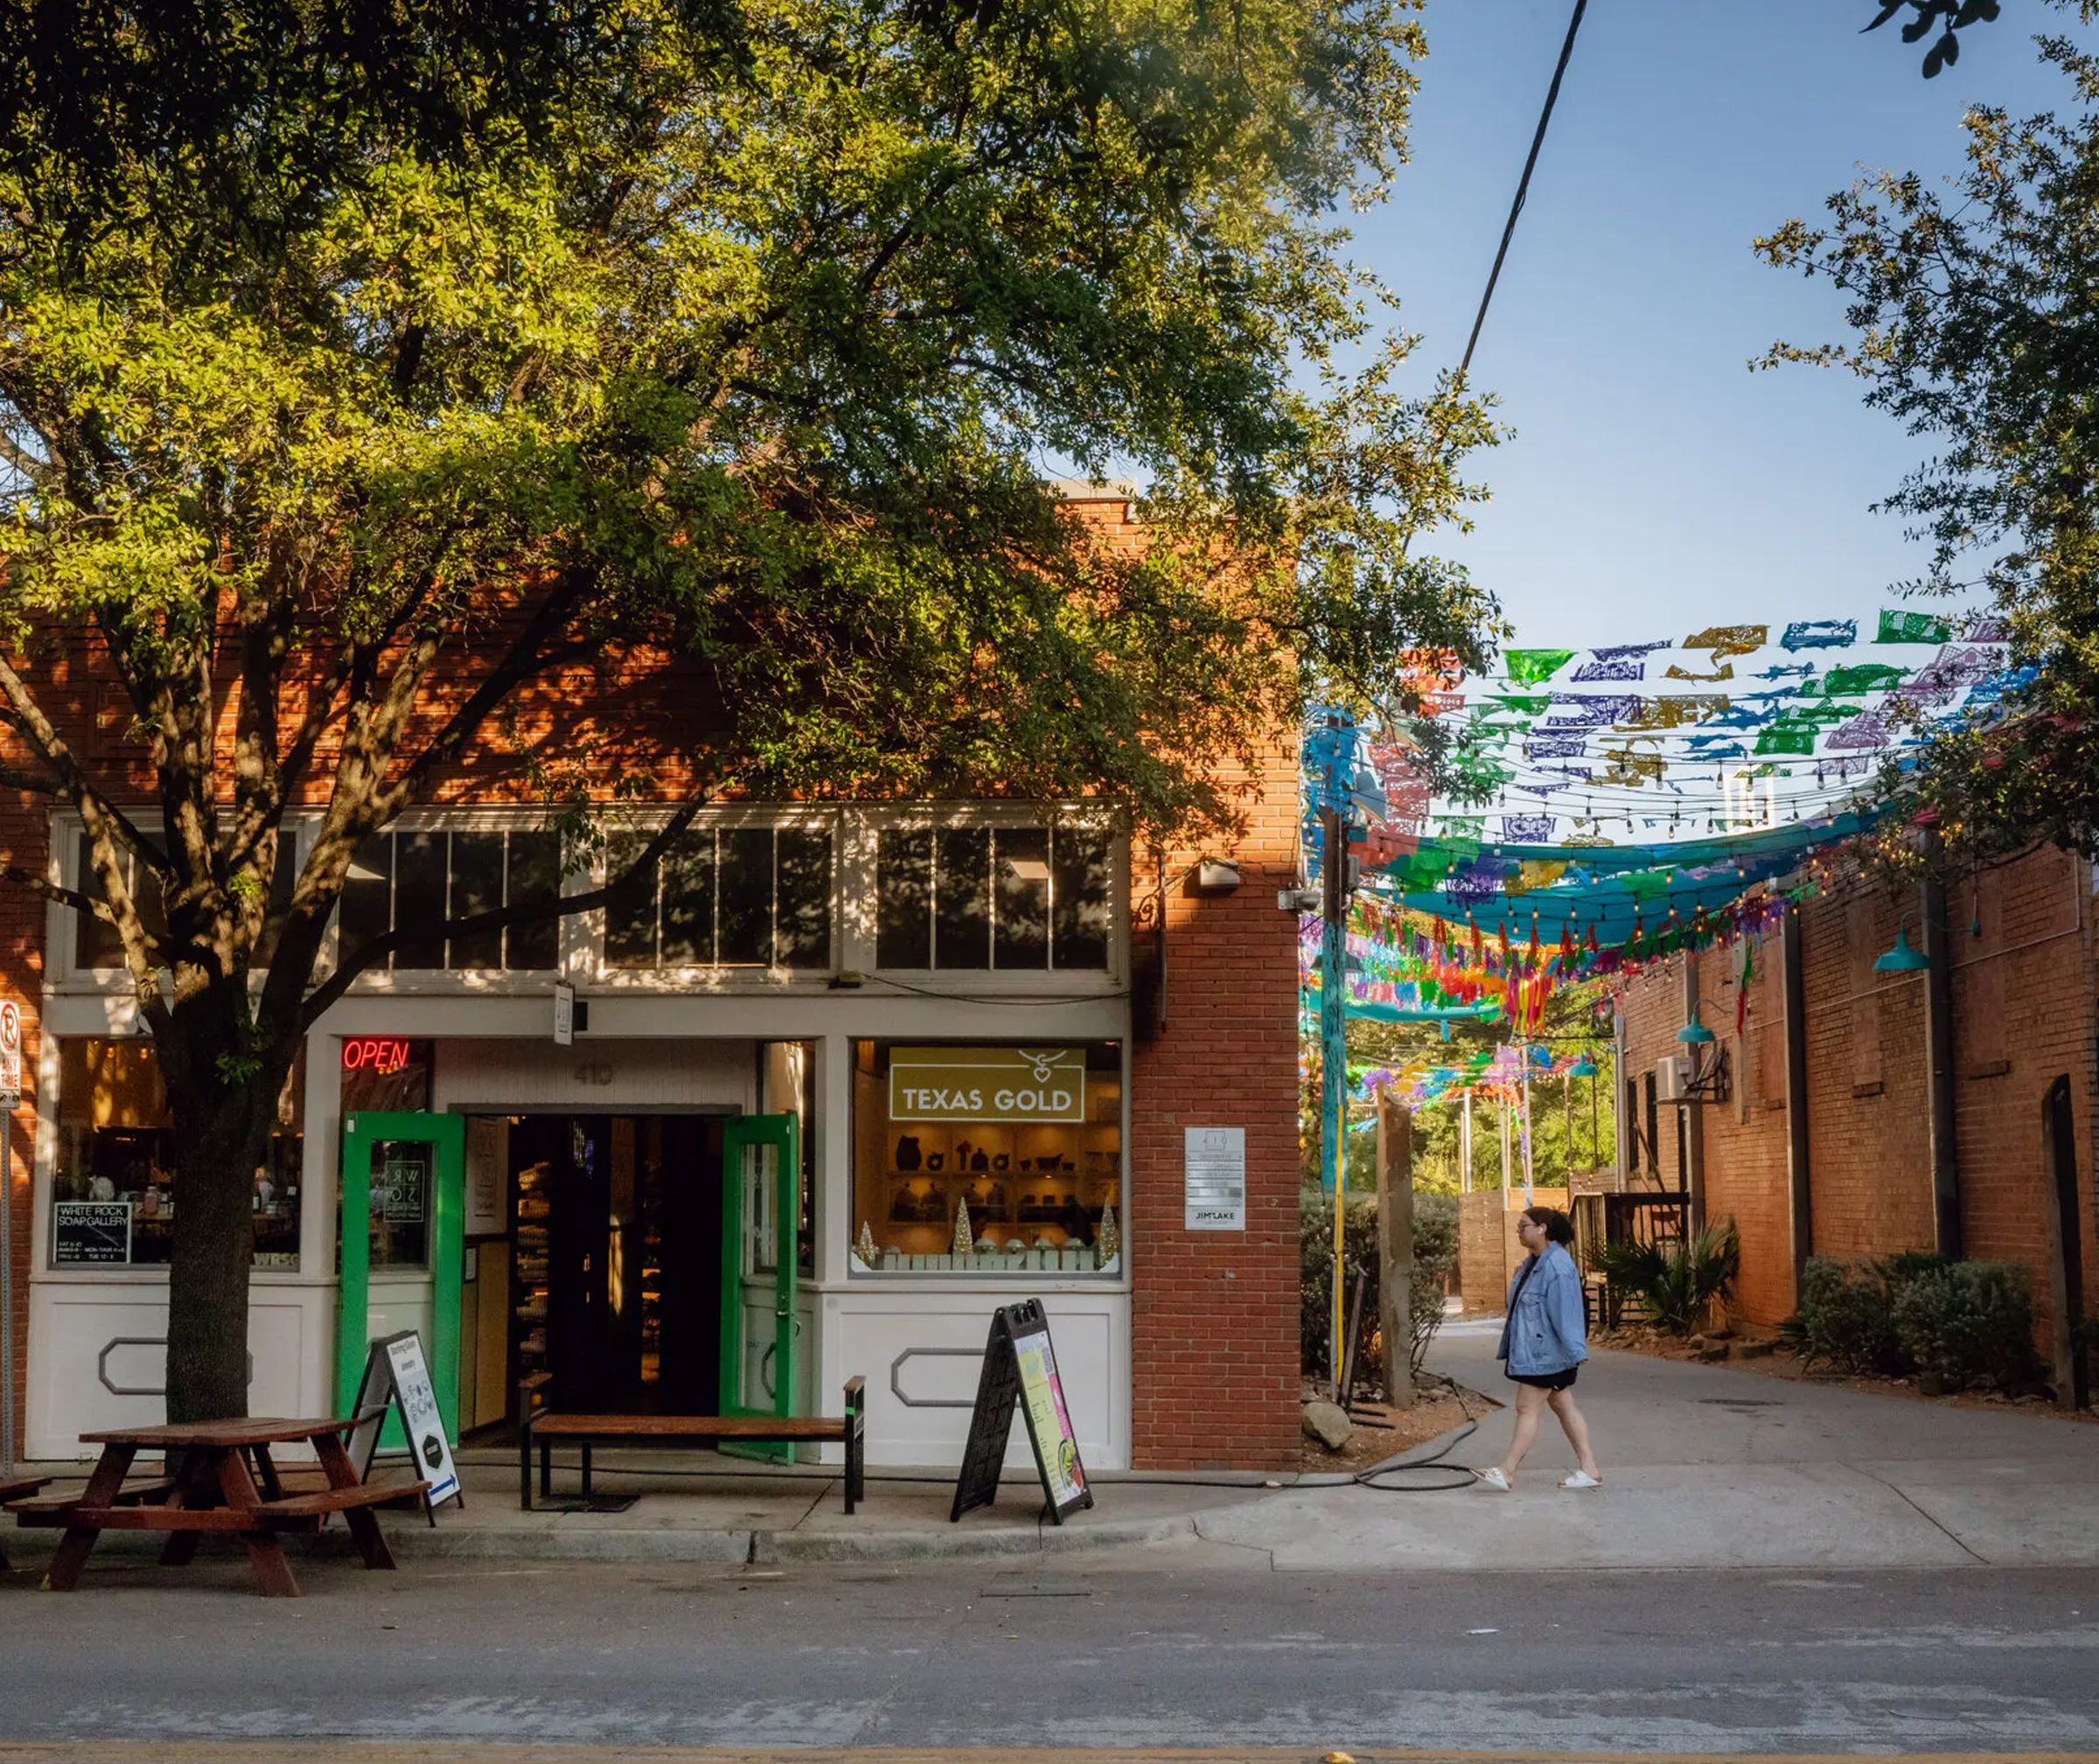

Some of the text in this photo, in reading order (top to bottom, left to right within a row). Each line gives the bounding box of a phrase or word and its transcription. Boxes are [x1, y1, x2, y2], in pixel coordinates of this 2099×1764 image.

[344, 1041, 409, 1068] OPEN
[903, 1088, 1071, 1111] TEXAS GOLD
[60, 1207, 123, 1216] WHITE ROCK
[59, 1217, 128, 1227] SOAP GALLERY
